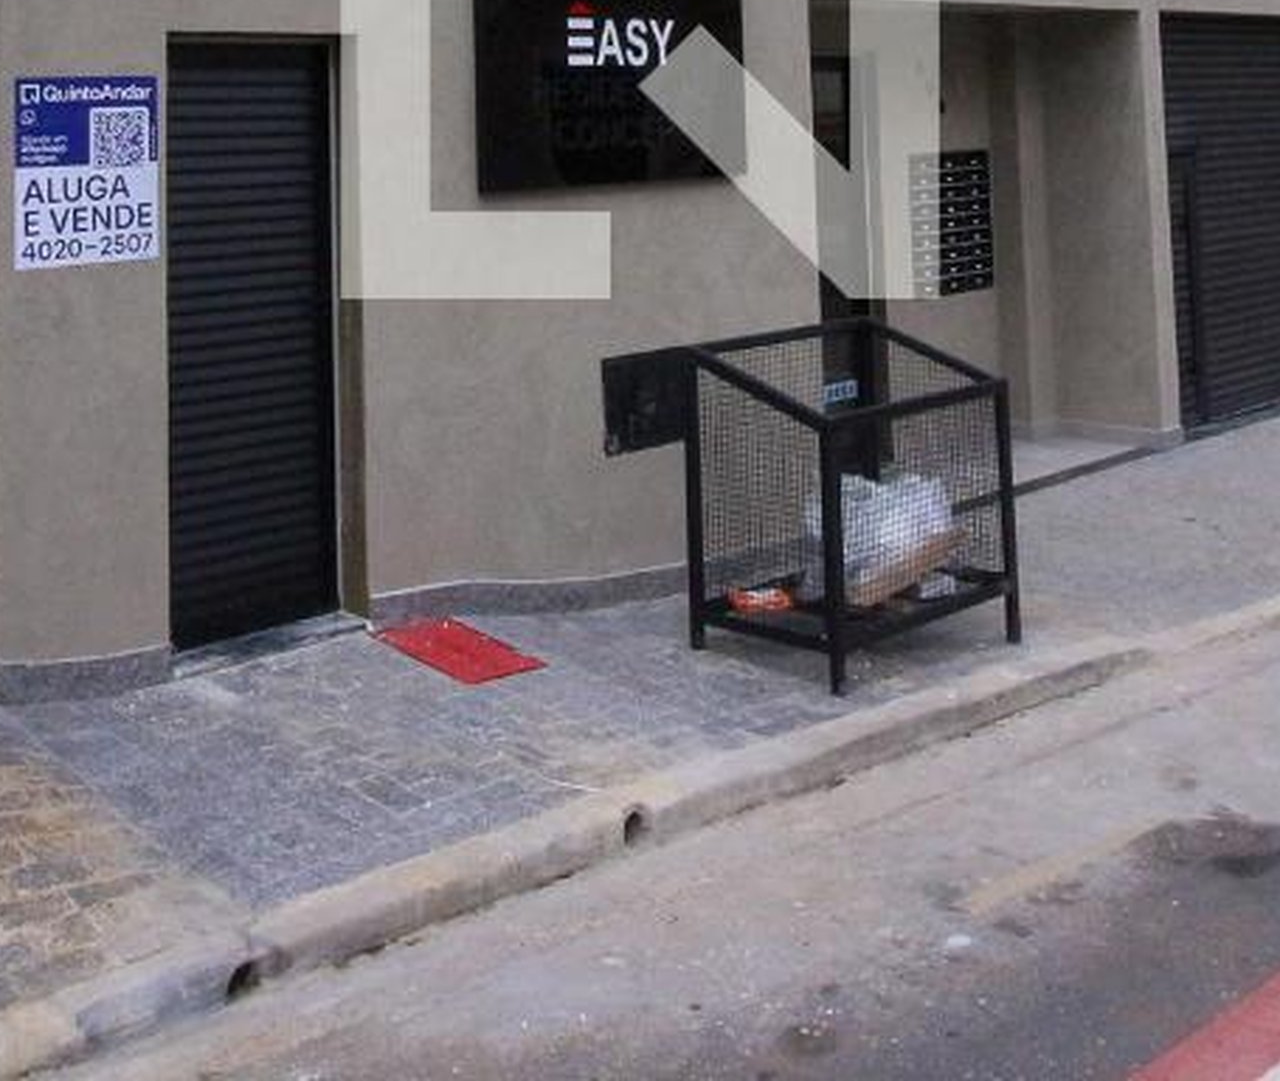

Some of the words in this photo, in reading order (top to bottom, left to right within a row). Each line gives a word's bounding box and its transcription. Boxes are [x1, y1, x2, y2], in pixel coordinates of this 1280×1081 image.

[567, 17, 674, 67] EASY
[42, 84, 152, 103] QuintoAndar
[23, 174, 131, 206] ALUGA
[24, 210, 40, 237] E
[50, 202, 153, 235] VENDE
[22, 233, 153, 262] 4020-2507
